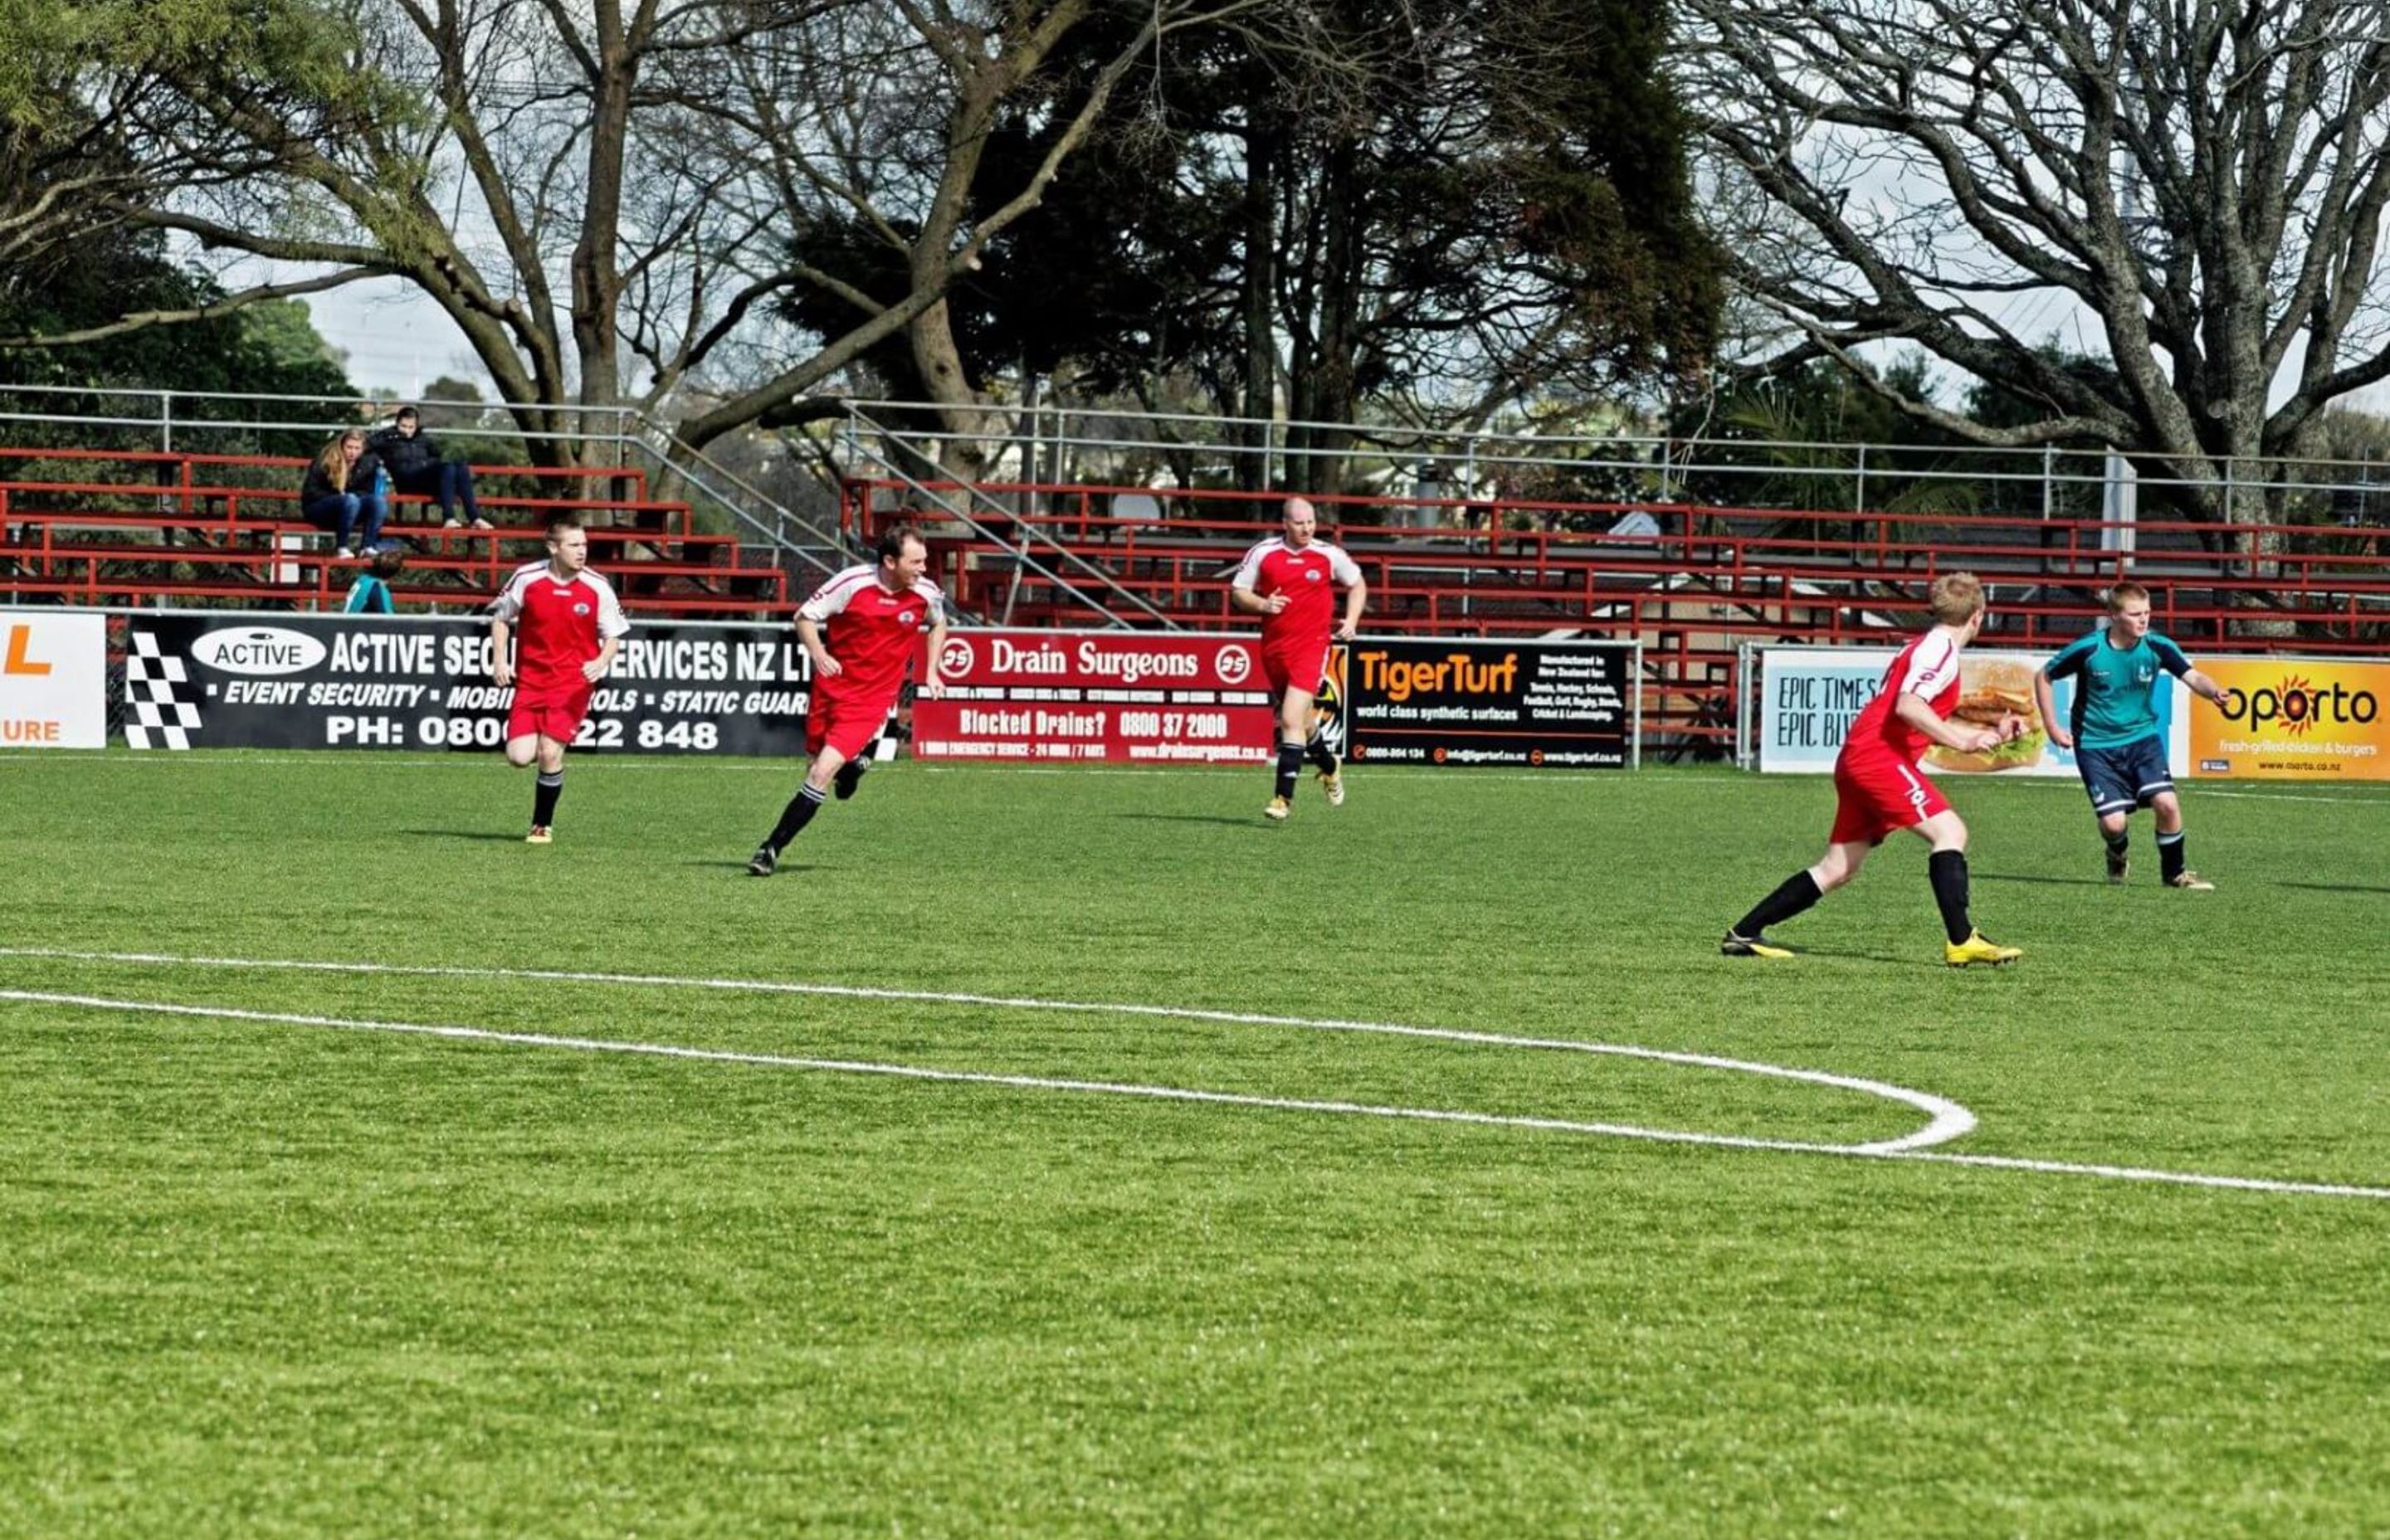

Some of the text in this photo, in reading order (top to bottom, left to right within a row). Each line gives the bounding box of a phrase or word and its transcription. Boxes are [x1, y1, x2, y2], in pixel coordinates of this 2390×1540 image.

[214, 644, 302, 664] ACTIVE
[330, 632, 436, 673] ACTIVE
[443, 636, 517, 675] SEC
[599, 638, 727, 679] ERVICES
[736, 643, 776, 680] NZ
[991, 640, 1198, 683] Drain Surgeons
[1358, 651, 1518, 701] TigerTurf
[224, 681, 305, 704] EVENT
[308, 683, 426, 706] SECURITY
[661, 690, 739, 714] STATIC
[744, 692, 809, 714] GUAR
[1778, 677, 1817, 709] EPIC
[2220, 682, 2378, 732] oporto
[960, 709, 1106, 737] Blocked Drains?
[1120, 712, 1227, 738] 0800 37 2000
[1356, 704, 1519, 722] world class synthetic surfaces
[327, 716, 403, 743] PH:
[418, 718, 509, 745] 080
[637, 720, 718, 748] 848
[1778, 712, 1817, 747] EPIC
[2334, 742, 2378, 757] burgers
